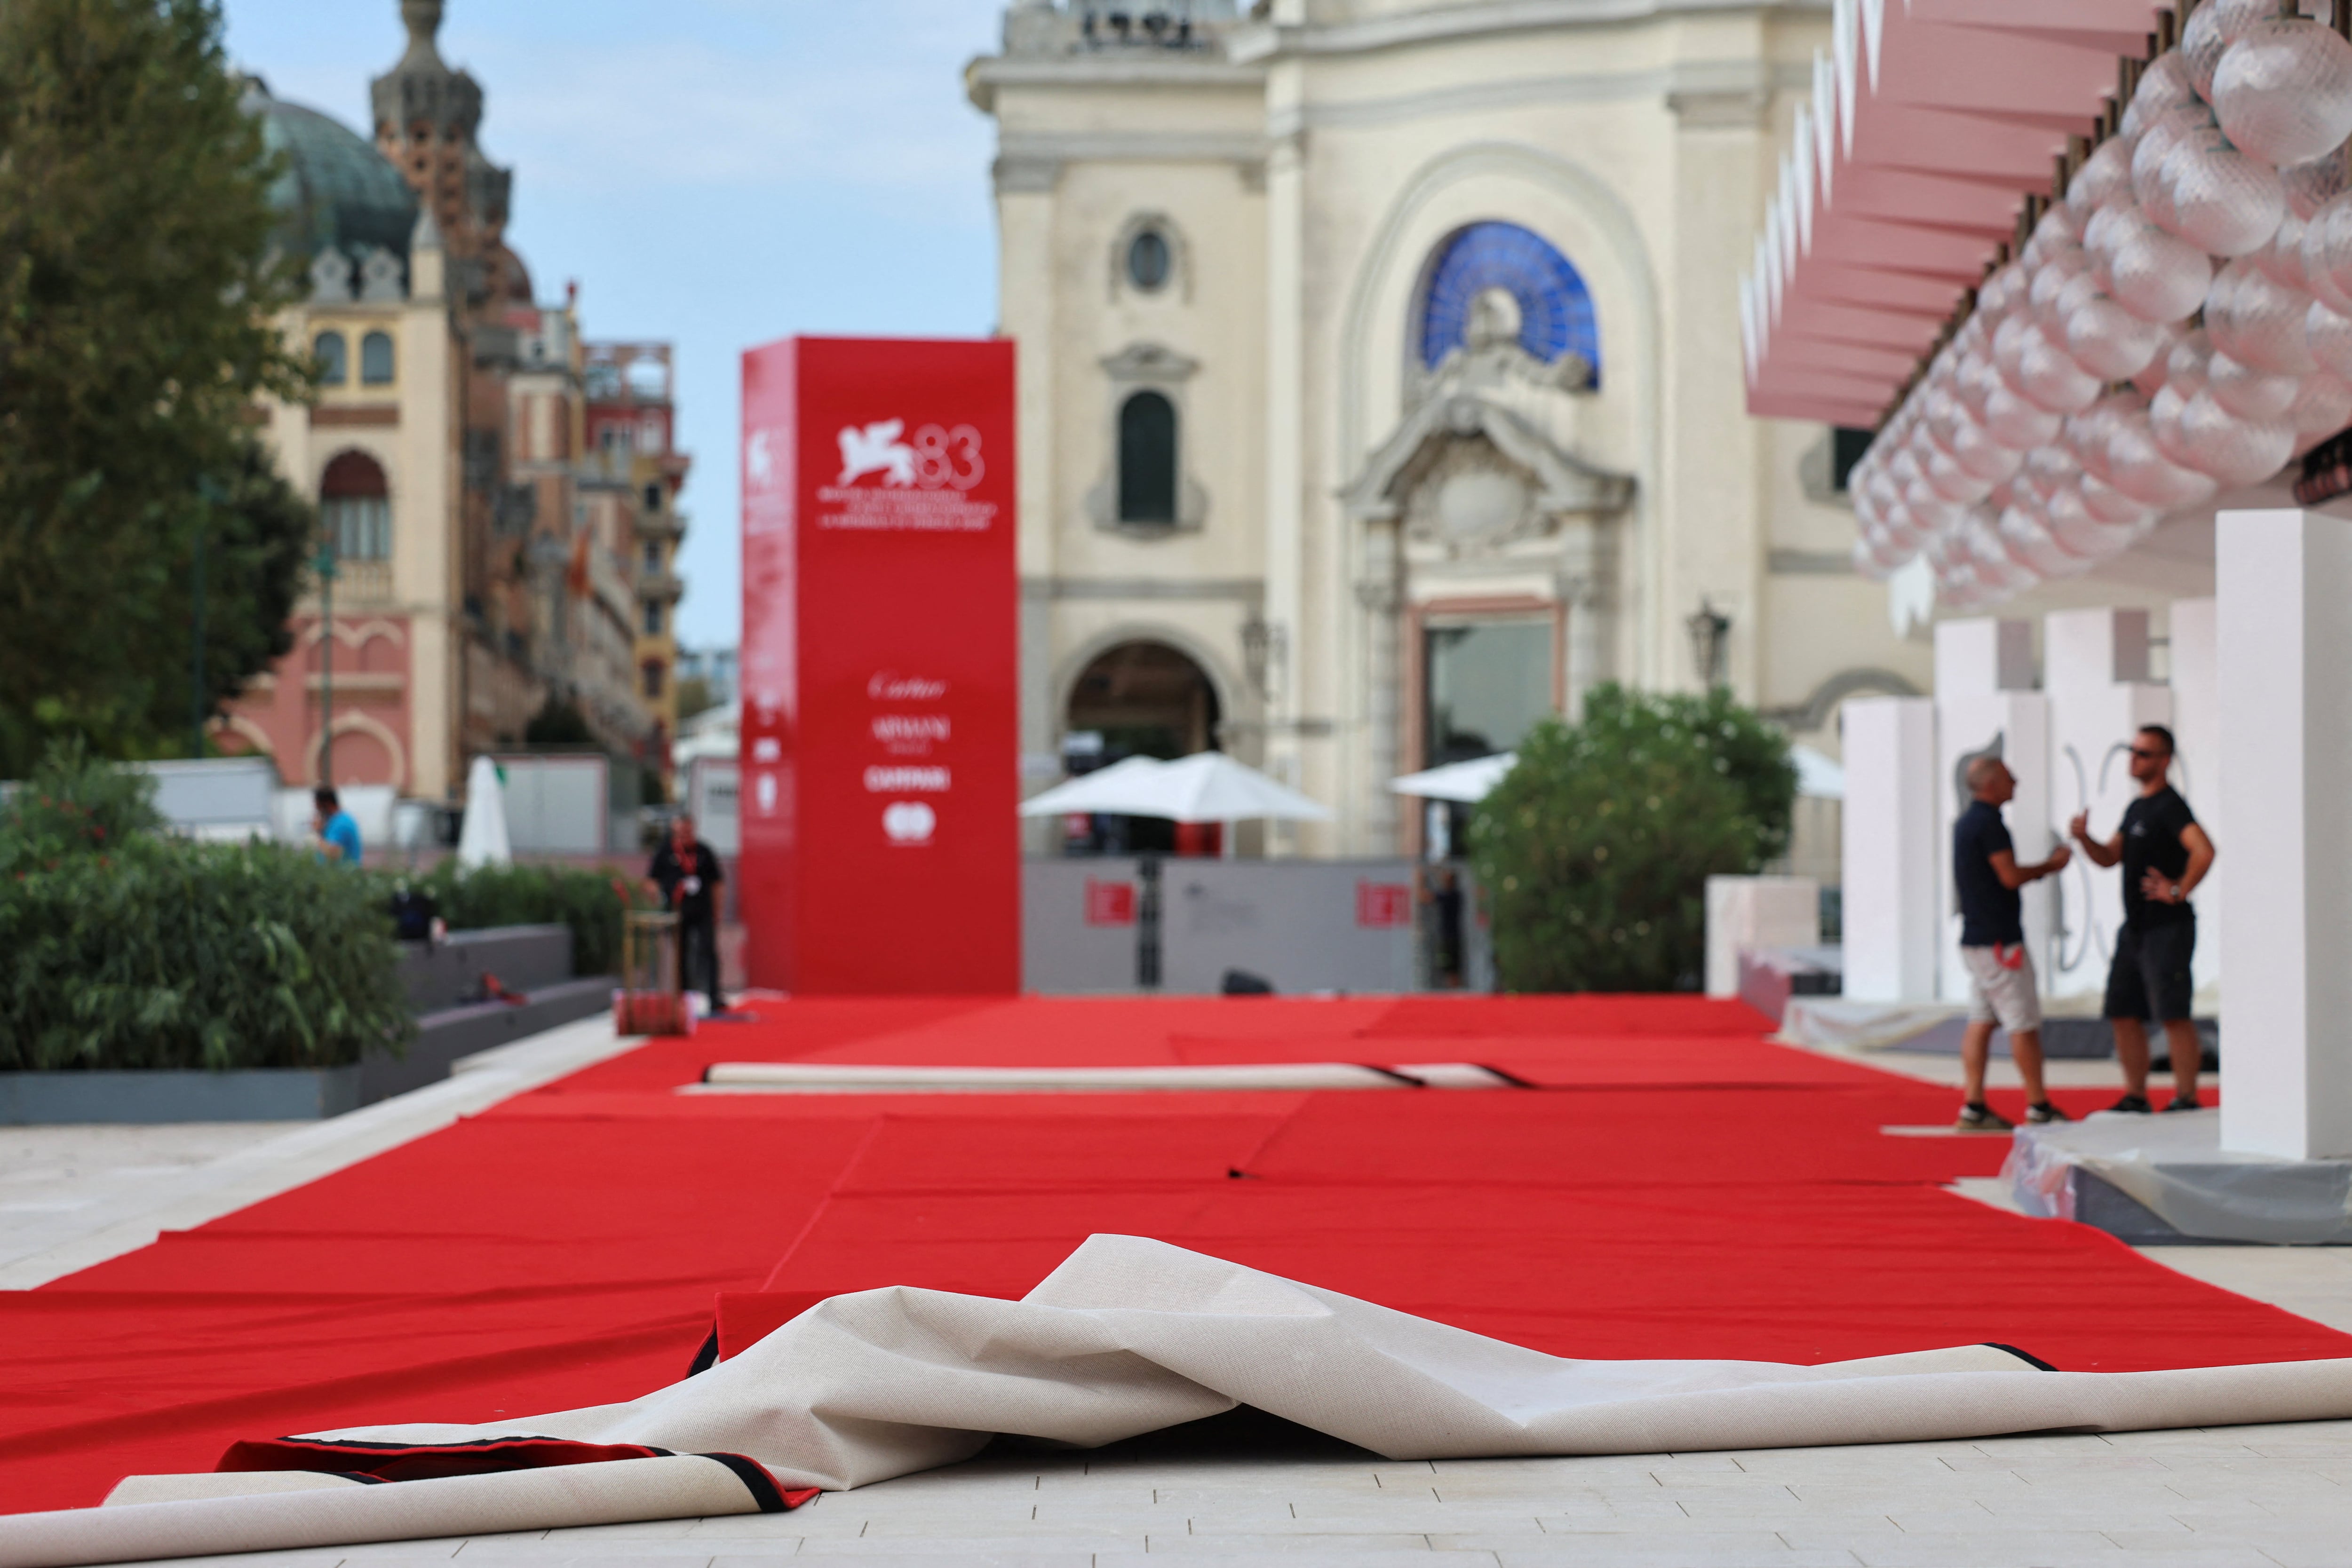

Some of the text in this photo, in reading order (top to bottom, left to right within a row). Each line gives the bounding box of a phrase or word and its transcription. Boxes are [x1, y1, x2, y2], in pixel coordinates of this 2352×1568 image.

[913, 423, 985, 491] 83
[869, 671, 948, 698] Cartier
[870, 715, 949, 740] ARMANI
[865, 767, 950, 791] CAMPARI
